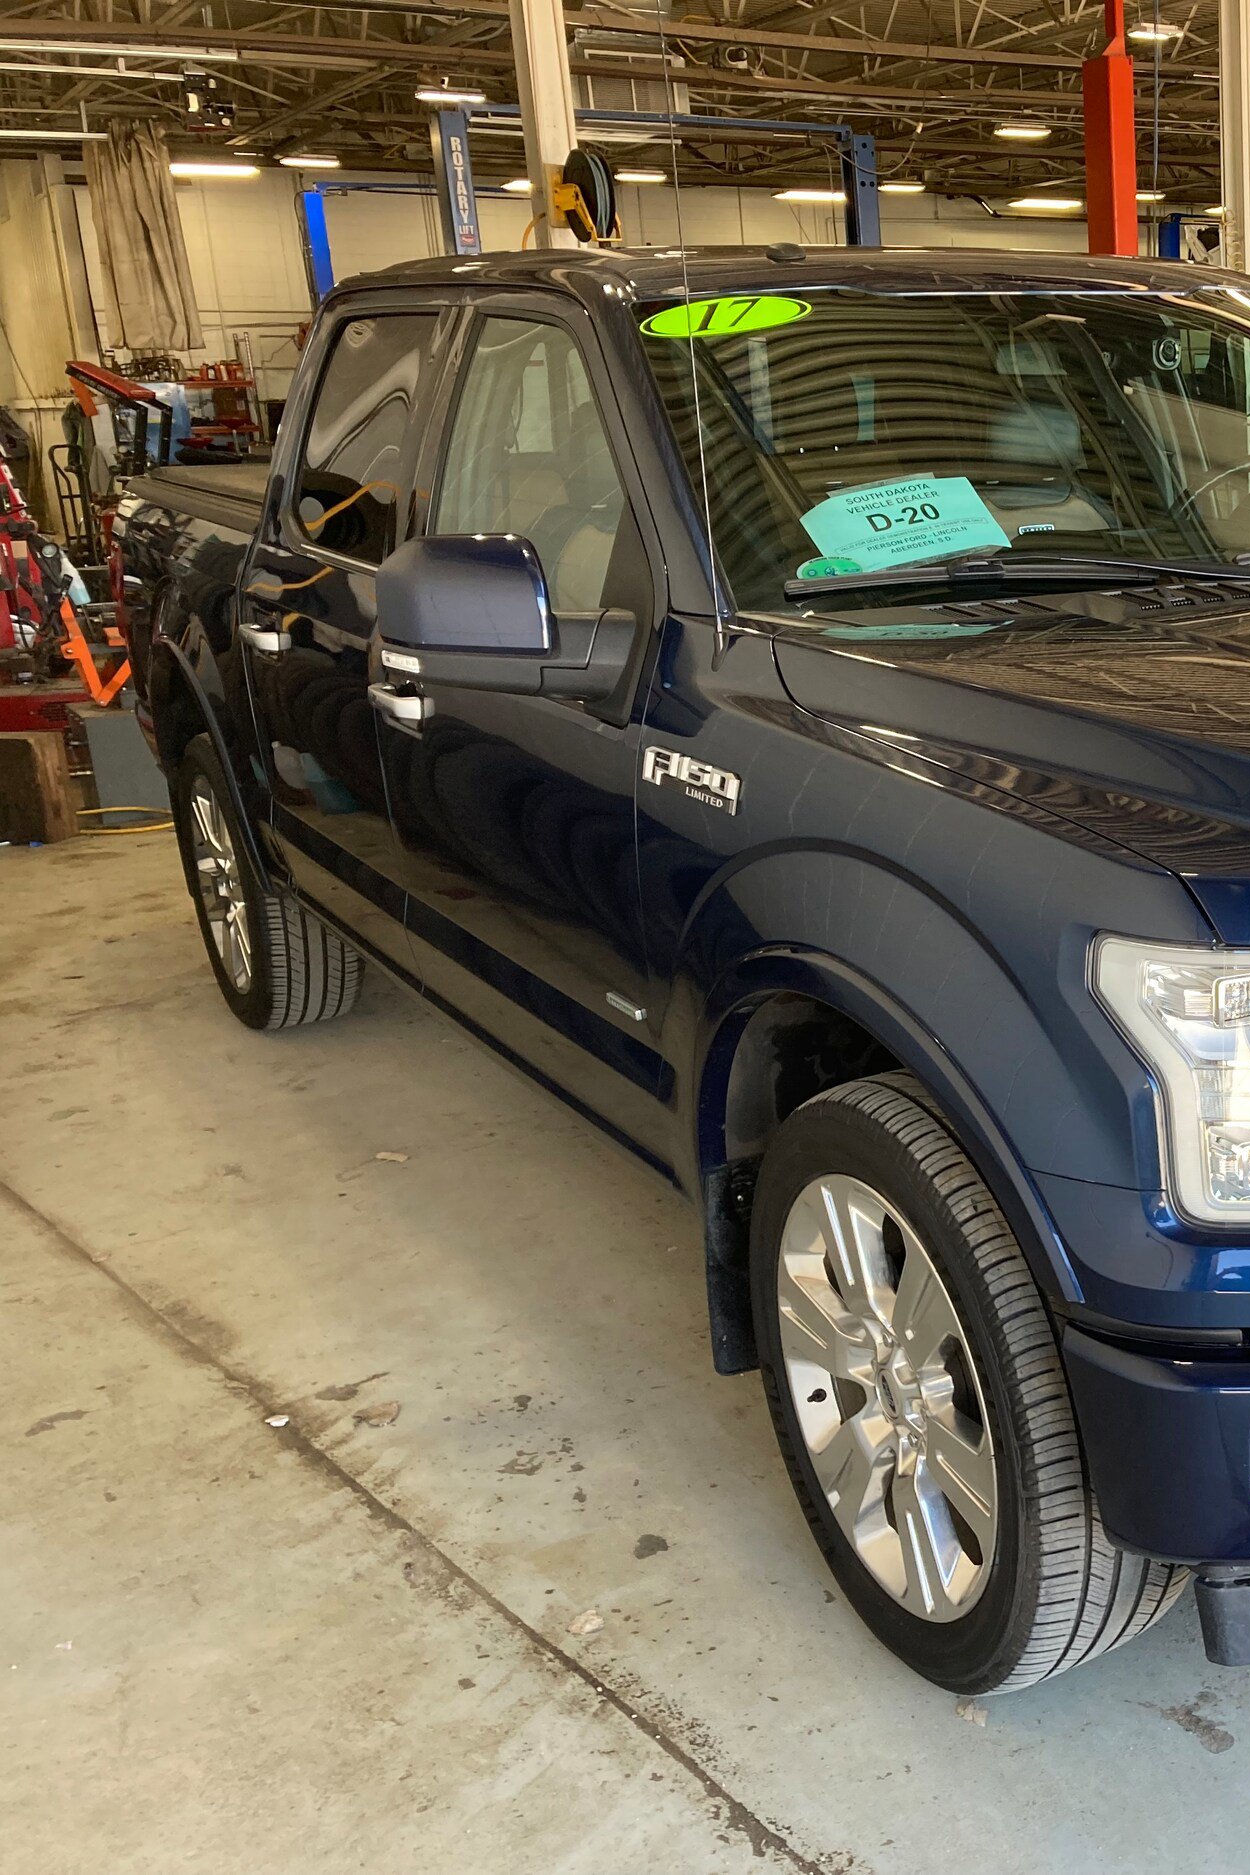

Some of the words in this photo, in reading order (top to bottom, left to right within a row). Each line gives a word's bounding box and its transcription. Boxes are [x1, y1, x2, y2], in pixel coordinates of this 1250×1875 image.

[449, 136, 469, 224] ROTARY
[458, 225, 474, 235] LIFT
[696, 297, 762, 331] 17
[845, 491, 884, 505] SOUTH
[884, 483, 931, 497] DAKOTA
[846, 499, 894, 515] VEHICLE
[895, 490, 940, 504] DEALER
[865, 503, 940, 532] D-20
[866, 538, 904, 553] PIERSON
[904, 533, 928, 544] FORD
[932, 526, 969, 538] LINCOLN
[685, 786, 724, 808] LIMITED
